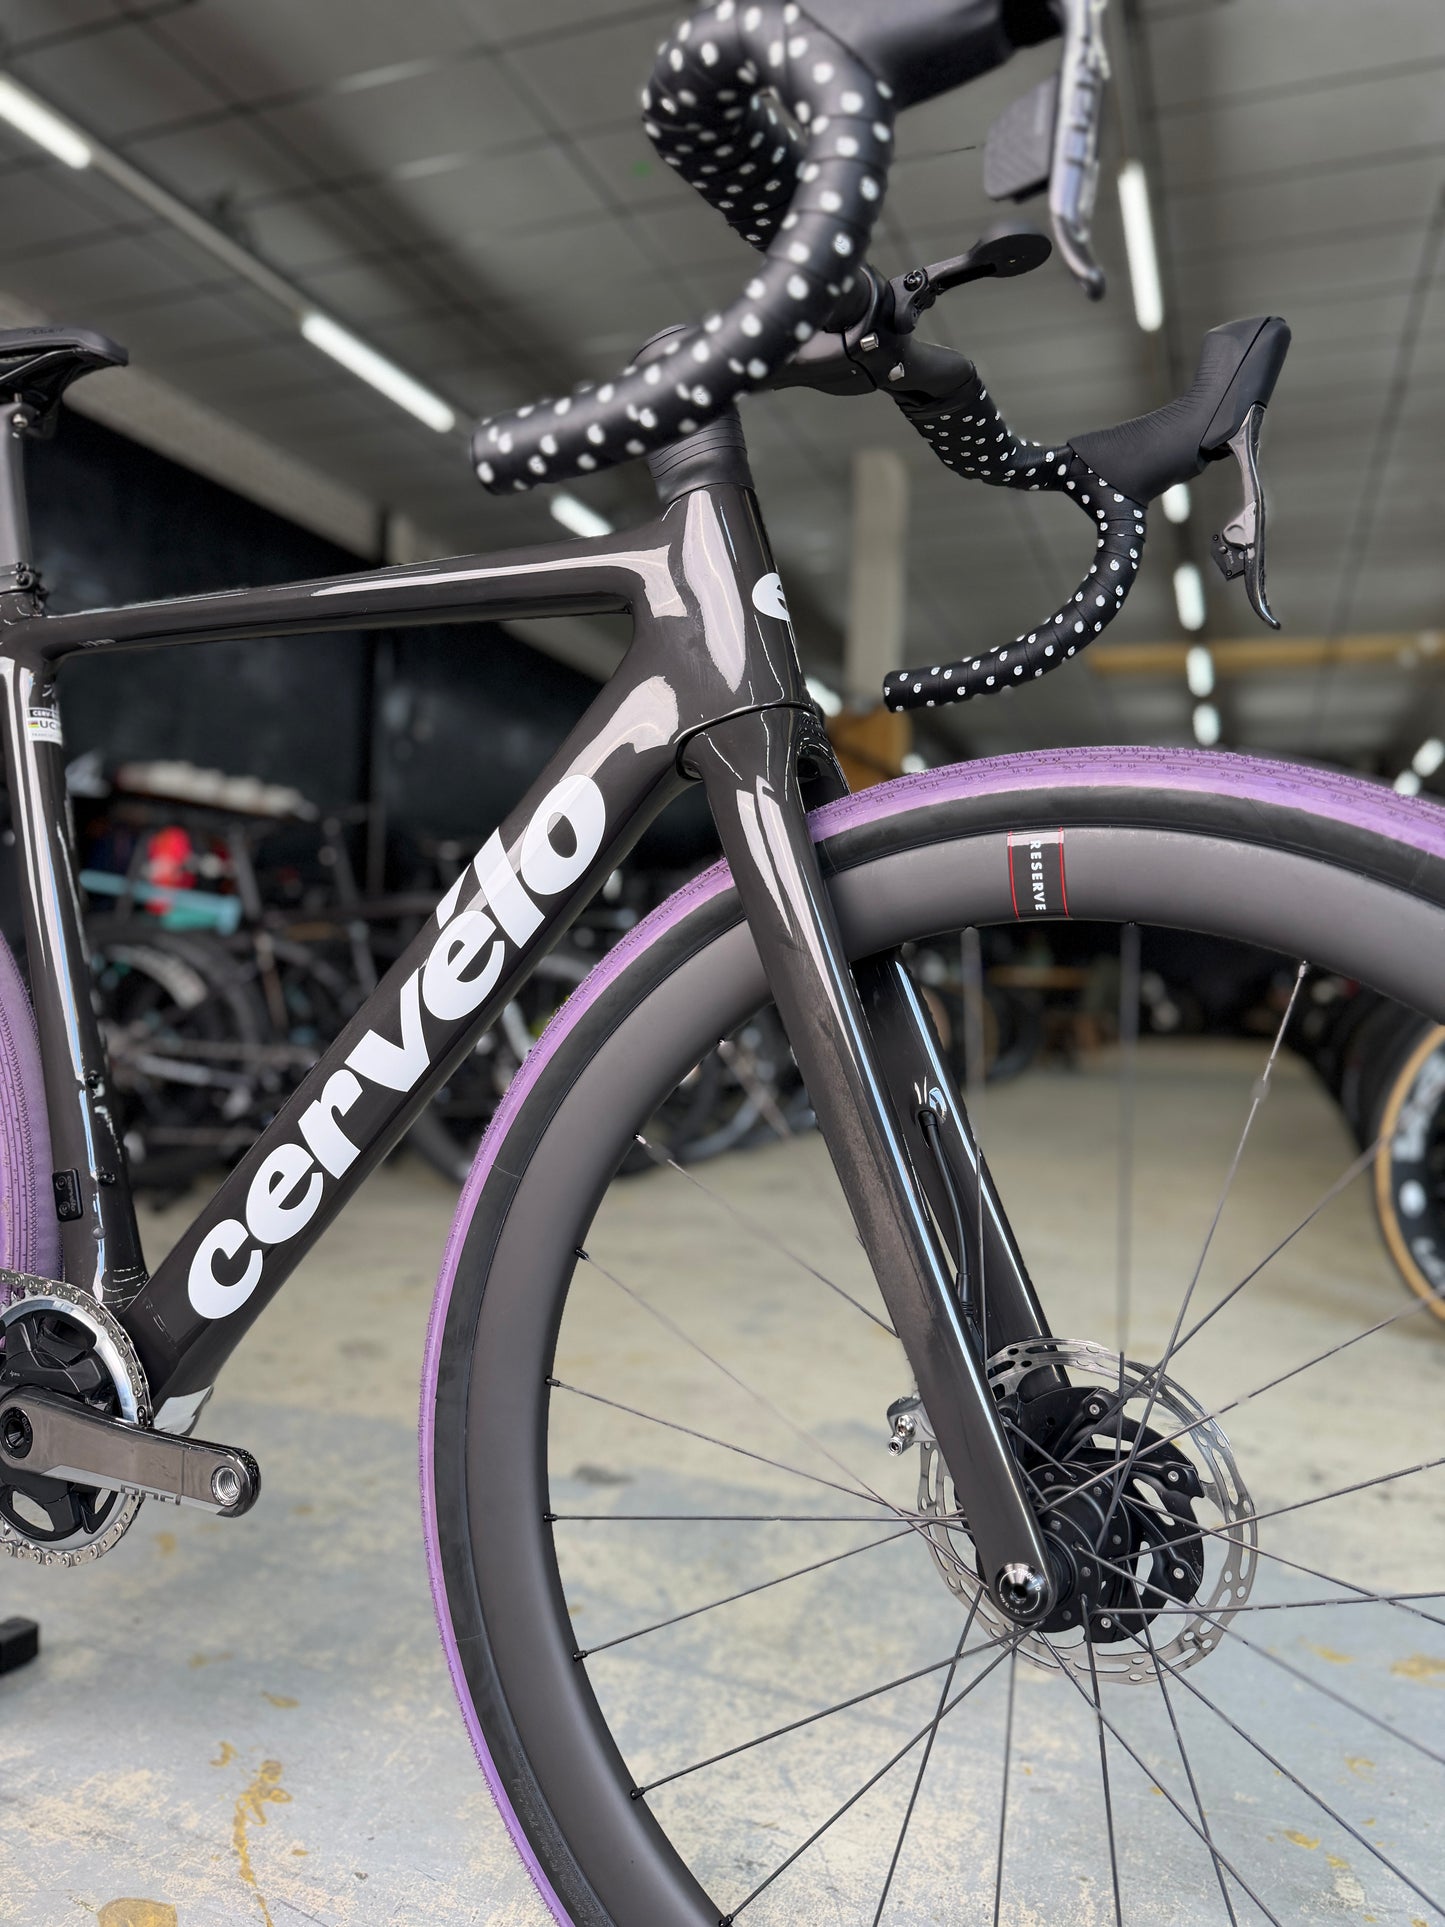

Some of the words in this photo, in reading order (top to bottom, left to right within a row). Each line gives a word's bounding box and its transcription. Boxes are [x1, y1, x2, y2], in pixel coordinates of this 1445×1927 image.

[40, 720, 58, 730] UC
[1030, 840, 1046, 911] RESERVE
[188, 774, 606, 1319] cervélo
